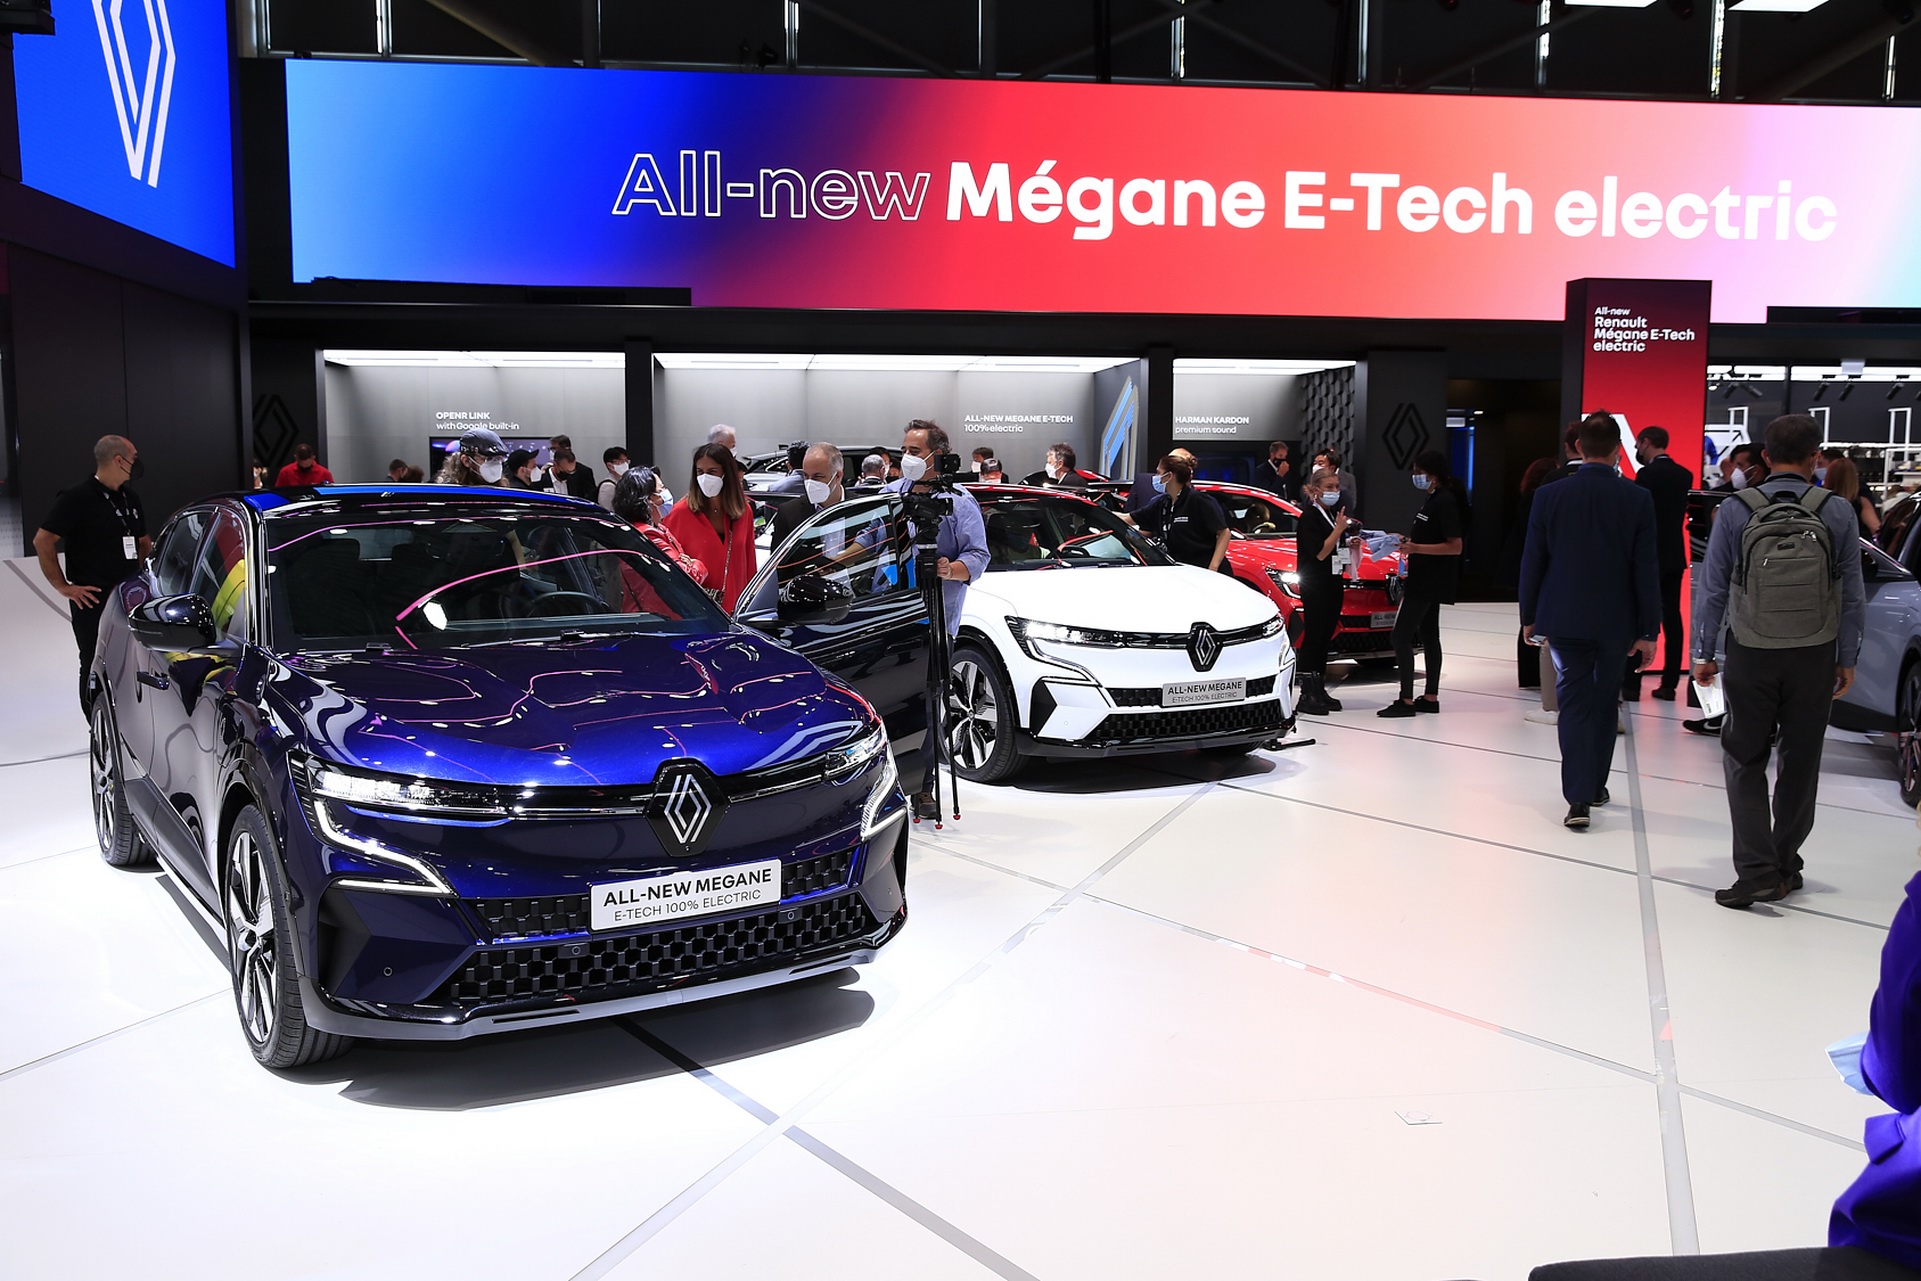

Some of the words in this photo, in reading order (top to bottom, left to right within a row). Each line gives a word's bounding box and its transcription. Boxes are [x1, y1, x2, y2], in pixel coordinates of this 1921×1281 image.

[611, 149, 932, 221] All-new
[945, 159, 1266, 241] Mégane
[1283, 170, 1533, 234] E-Tech
[1553, 175, 1838, 242] electric
[1594, 306, 1631, 316] All-new
[1594, 316, 1648, 328] Renault
[1593, 328, 1649, 342] Mégane
[1650, 329, 1695, 341] E-Tech
[1593, 340, 1646, 352] electric
[435, 411, 468, 420] OPENR
[468, 411, 491, 420] LINK
[964, 414, 1005, 422] ALL-NEW
[1005, 414, 1042, 423] MEGANE
[1042, 415, 1074, 423] E-TECH
[1175, 416, 1212, 424] HARMAN
[1213, 416, 1250, 424] KARDON
[436, 422, 456, 430] with
[489, 421, 520, 430] built-in
[1175, 426, 1211, 434] premium
[1212, 426, 1237, 434] sound
[1167, 684, 1208, 695] ALL-NEW
[1207, 681, 1243, 692] MEGANE
[1172, 695, 1194, 704] E-TECH
[603, 880, 692, 907] ALL-NEW
[695, 868, 772, 894] MEGANE
[614, 904, 662, 922] E-TECH
[665, 901, 699, 915] 100%
[703, 888, 762, 909] ELECTRIC
